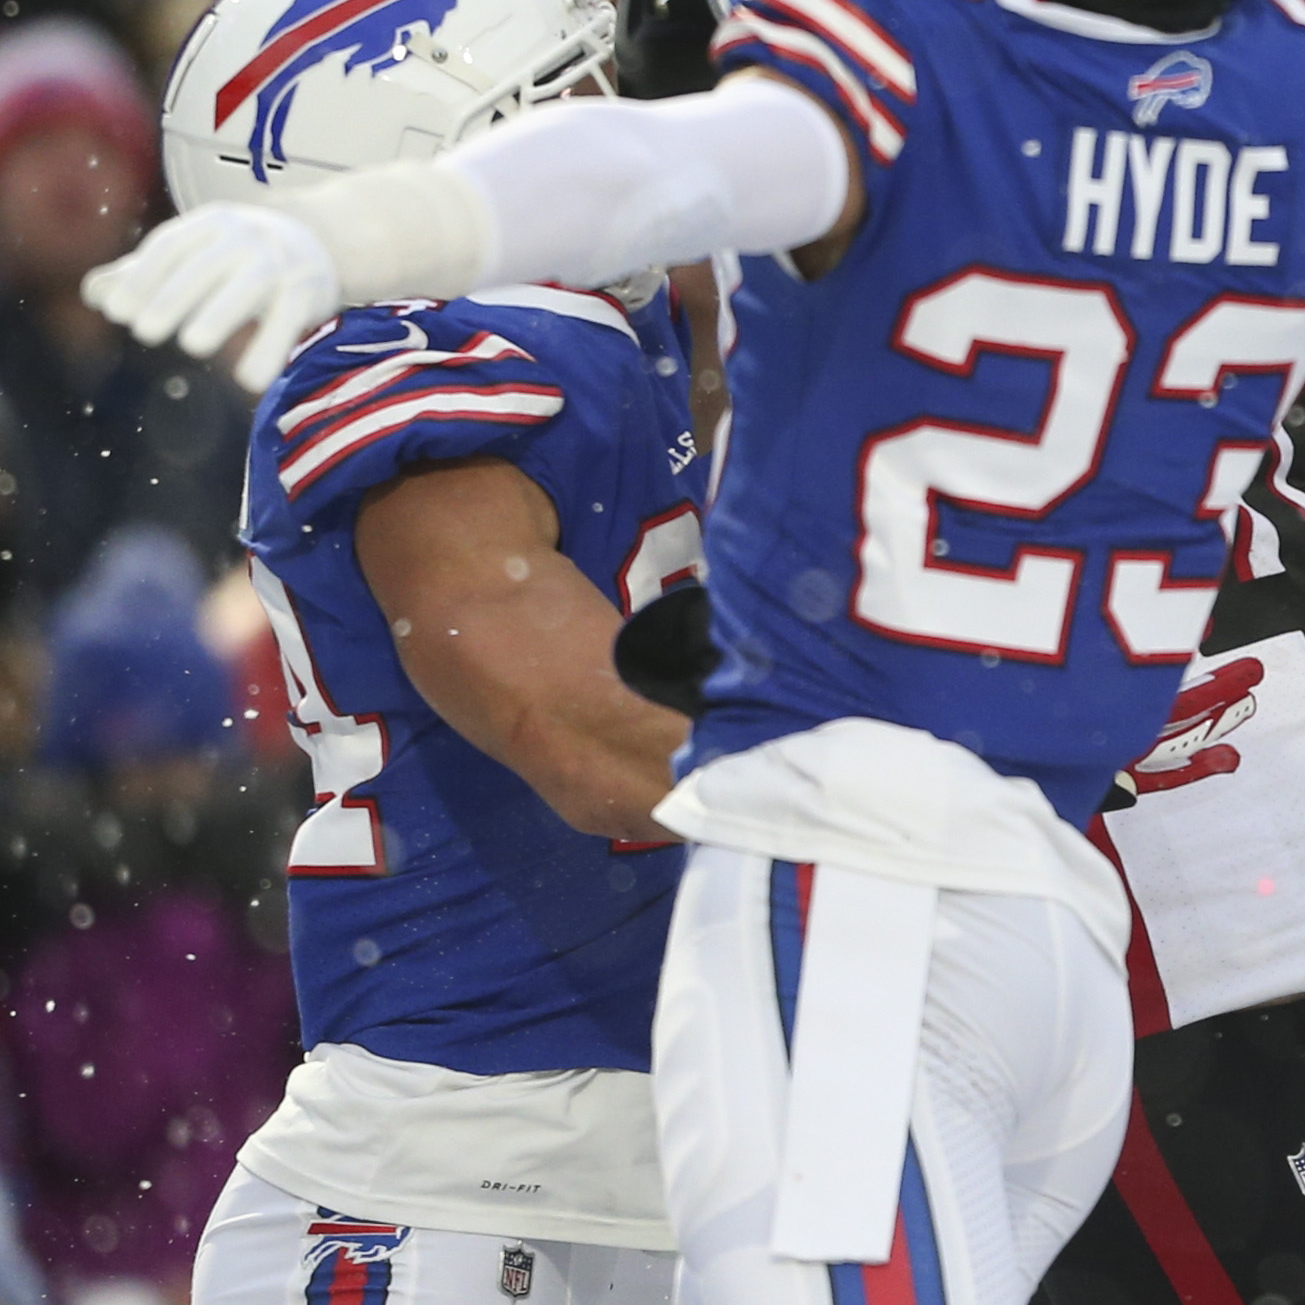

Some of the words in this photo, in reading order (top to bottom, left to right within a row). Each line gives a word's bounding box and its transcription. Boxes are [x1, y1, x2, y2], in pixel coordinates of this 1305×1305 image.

[1062, 127, 1289, 266] HYDE
[480, 1180, 541, 1194] DRI-FIT
[503, 1266, 529, 1293] NFL
